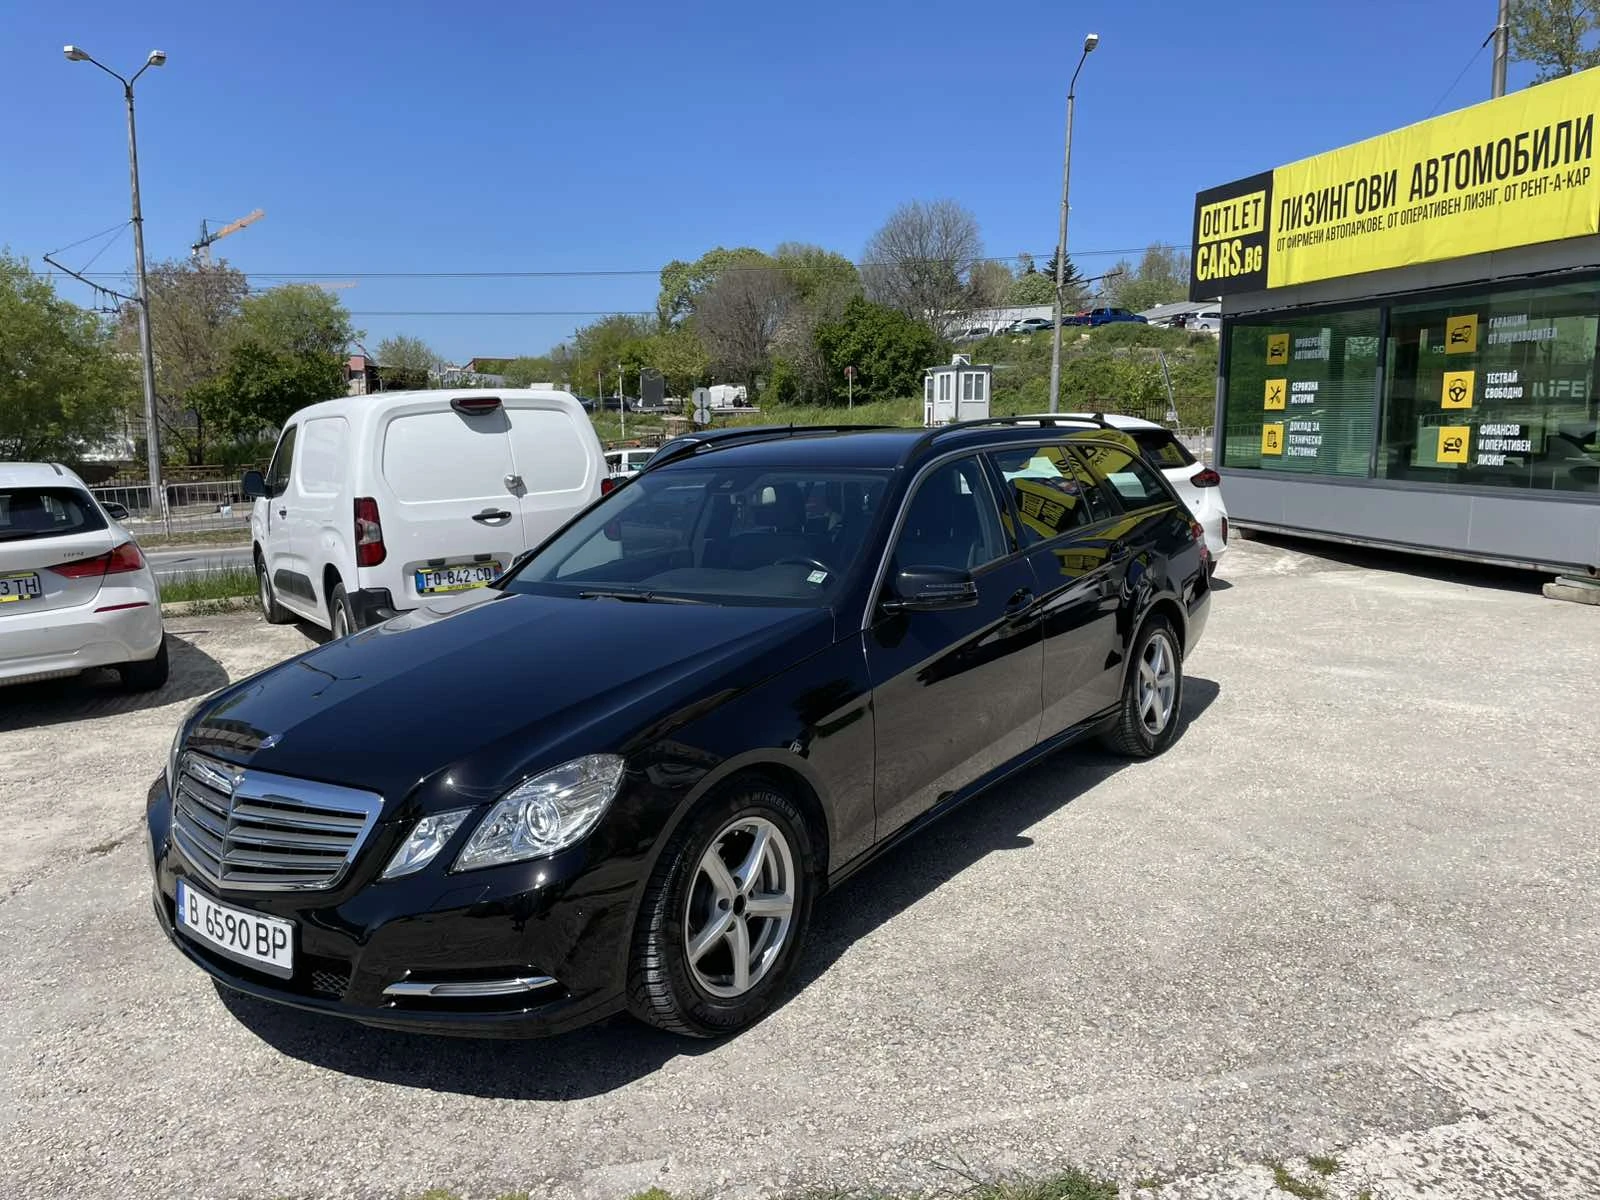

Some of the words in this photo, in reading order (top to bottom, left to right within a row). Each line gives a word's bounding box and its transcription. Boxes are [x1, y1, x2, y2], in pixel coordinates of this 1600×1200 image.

[1278, 169, 1397, 232] ЛИЗИНГОВИ
[1409, 114, 1594, 202] АВТОМОБИЛИ
[1276, 237, 1286, 252] ОТ
[1286, 231, 1324, 249] ФИРМЕНИ
[1325, 215, 1386, 243] АВТОПАРКОВЕ,
[1387, 211, 1399, 229] ОТ
[1400, 198, 1461, 226] ОПЕРАТИВЕН
[1504, 183, 1518, 202] ОТ
[1520, 166, 1591, 199] РЕНТ-А-КАР
[1203, 198, 1262, 237] OUTLET
[1196, 239, 1263, 281] CARS.BG
[1488, 333, 1497, 344] ОТ
[1487, 370, 1518, 384] ТЕСТВАЙ
[1291, 381, 1318, 392] СЕРВИЗНА
[1485, 387, 1523, 399] СВОБОДНО
[1290, 393, 1314, 404] ИСТОРИЯ
[1289, 421, 1311, 432] ДОКЛАД
[1312, 421, 1320, 432] ЗА
[1480, 424, 1520, 436] ФИНАНСОВ
[1289, 434, 1322, 445] ТЕХНИЧЕСКО
[1478, 439, 1484, 450] И
[1485, 440, 1531, 452] ОПЕРАТИВЕН
[1477, 454, 1506, 466] ЛИЗИНГ
[13, 578, 37, 595] TH
[752, 791, 797, 818] MICHELIN
[189, 893, 199, 926] B
[206, 905, 251, 950] 6590
[256, 922, 287, 959] BP
